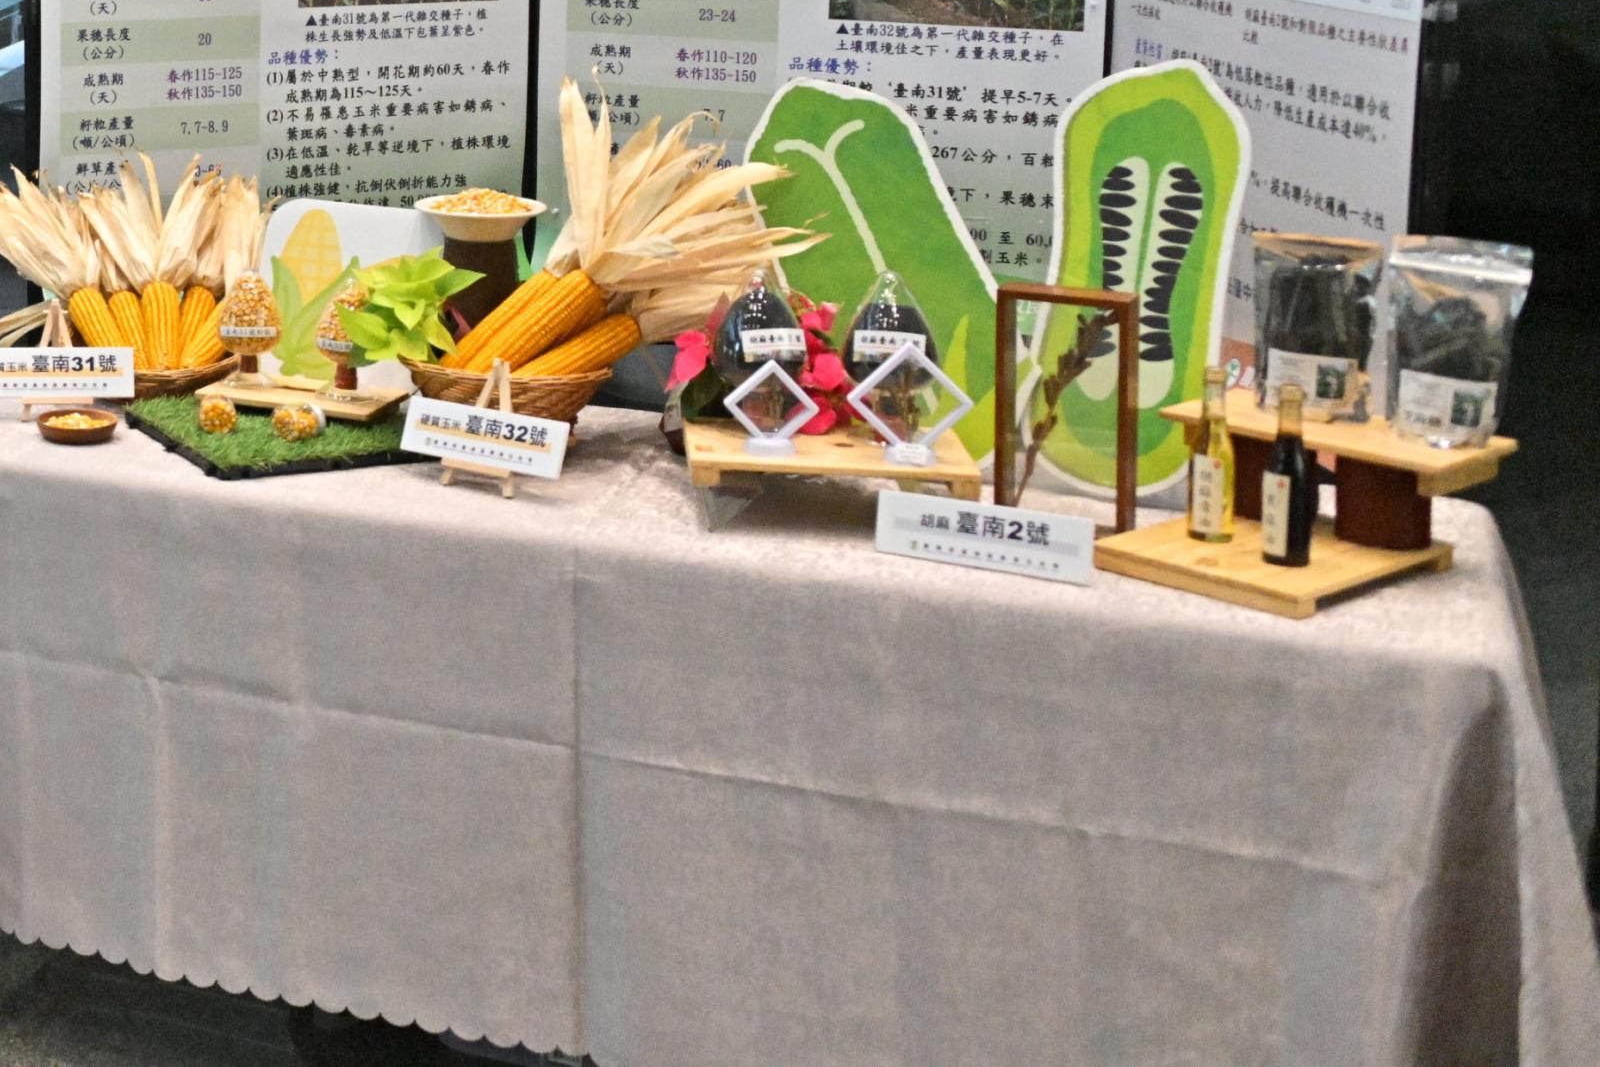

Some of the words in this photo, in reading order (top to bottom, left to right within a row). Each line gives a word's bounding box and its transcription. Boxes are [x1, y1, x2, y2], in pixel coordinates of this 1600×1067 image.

[89, 1, 118, 15] (天)
[318, 8, 488, 27] 臺南31號為第一代雜交種子，植
[699, 8, 736, 23] 23-24
[590, 11, 634, 28] (公分)
[76, 27, 131, 43] 果穗長度
[198, 33, 212, 46] 20
[850, 24, 1065, 47] 臺南32號為第一代雜交種子，在
[82, 45, 125, 61] (公分)
[267, 47, 339, 65] 品種優勢：
[590, 43, 632, 59] 成熟期
[675, 47, 757, 66] 春作110-120
[266, 61, 511, 86] (1)屬於中熟型，開花期約60天，春作
[675, 65, 757, 83] 秋作135-150
[788, 57, 873, 75] 品種優勢：
[83, 73, 124, 87] 成熟期
[167, 66, 242, 83] 春作115-125
[90, 90, 117, 104] (天)
[166, 85, 242, 101] 秋作135-150
[80, 116, 134, 132] 籽粒產量
[285, 162, 352, 180] 適應性佳。
[32, 354, 117, 373] 臺南31號
[420, 414, 461, 431] 硬質玉米
[466, 415, 548, 448] 臺南32號
[920, 513, 949, 530] 胡麻
[956, 511, 1049, 546] 臺南2號
